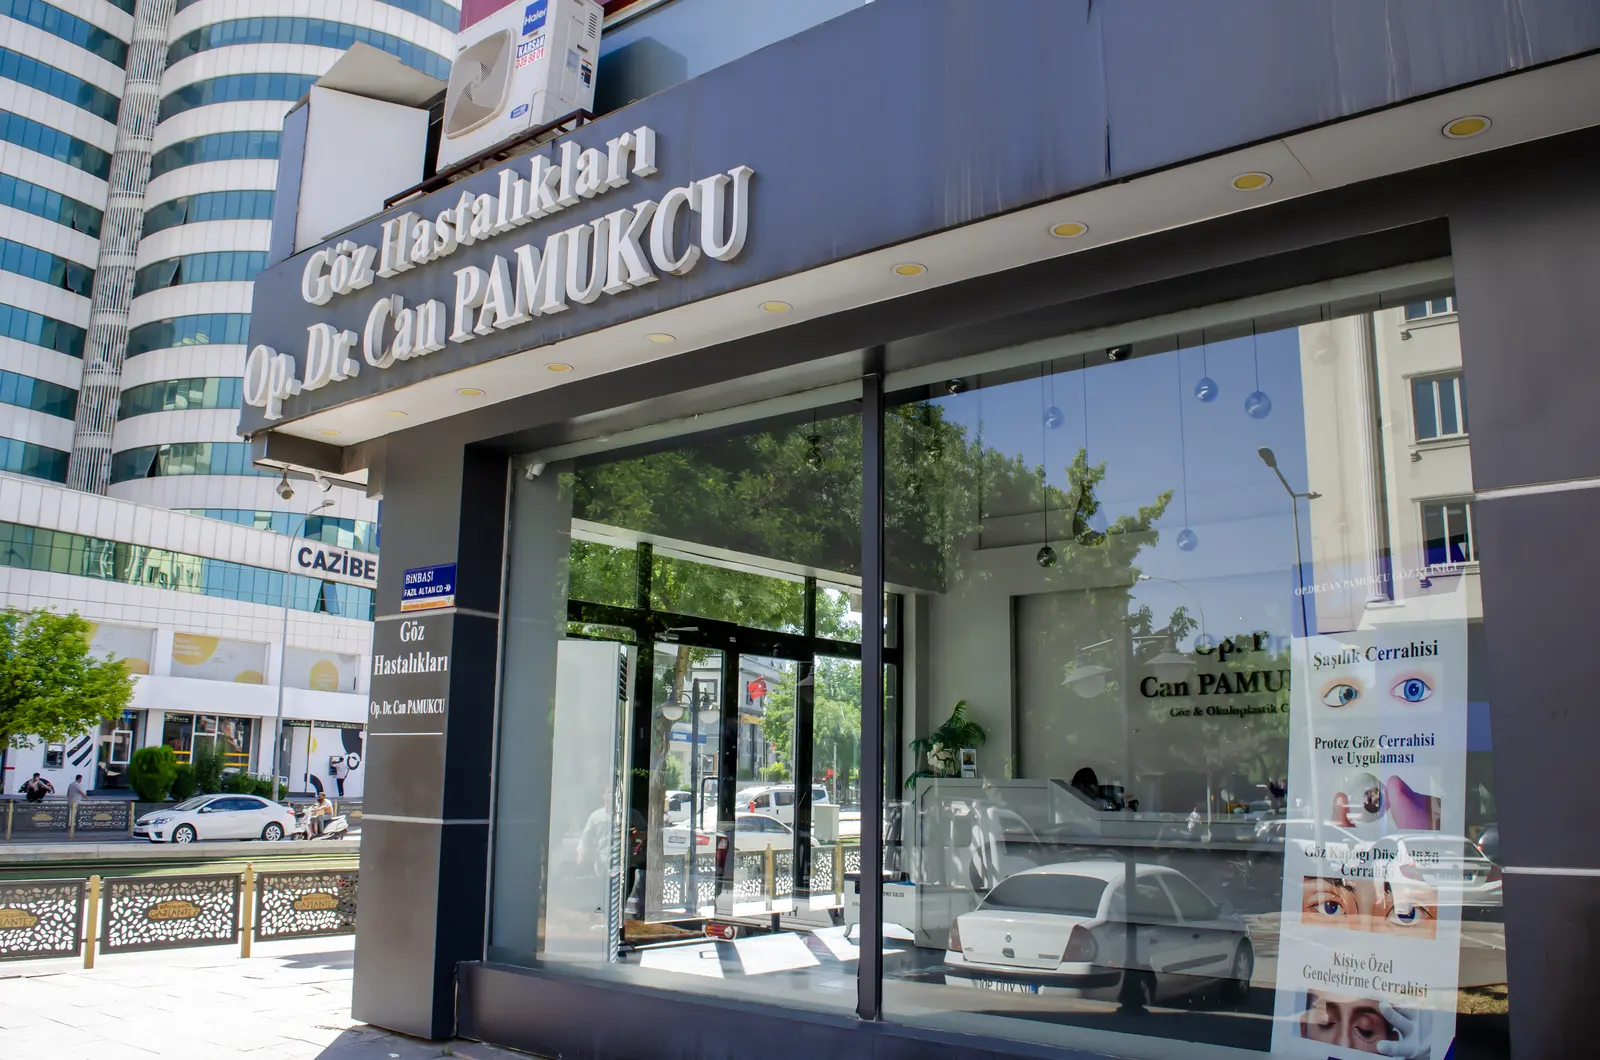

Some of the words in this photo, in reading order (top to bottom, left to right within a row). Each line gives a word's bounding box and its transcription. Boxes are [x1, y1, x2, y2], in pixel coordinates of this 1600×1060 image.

[524, 8, 548, 25] Haier
[301, 239, 378, 306] Göz
[376, 125, 657, 279] Hastalıkları
[243, 344, 302, 421] Op.
[301, 322, 361, 391] Dr.
[363, 293, 447, 370] Can
[448, 164, 756, 343] PAMUKCU
[297, 546, 377, 581] CAZİBE
[1392, 568, 1413, 582] GÖZ
[418, 584, 436, 596] ALTAN
[400, 620, 425, 643] Göz
[373, 651, 449, 676] Hastalıkları
[1313, 649, 1360, 671] Şaşılık
[1365, 639, 1438, 662] Cerrahisi
[1139, 676, 1190, 699] Can
[370, 700, 382, 719] Op.
[382, 700, 393, 715] Dr.
[393, 699, 407, 715] Can
[406, 698, 446, 715] PAMUKCU
[1193, 706, 1203, 717] &
[1206, 703, 1278, 719] Okuloplastik
[1314, 737, 1350, 750] Protez
[1352, 735, 1376, 749] Göz
[1378, 733, 1436, 748] Cerrahisi
[1331, 754, 1344, 765] ve
[1346, 751, 1415, 768] Uygulaması
[1303, 844, 1327, 859] Göz
[1333, 951, 1366, 973] Kişiye
[1368, 953, 1394, 975] Özel
[1302, 964, 1371, 988] Gençleştirme
[1372, 975, 1429, 999] Cerrahisi
